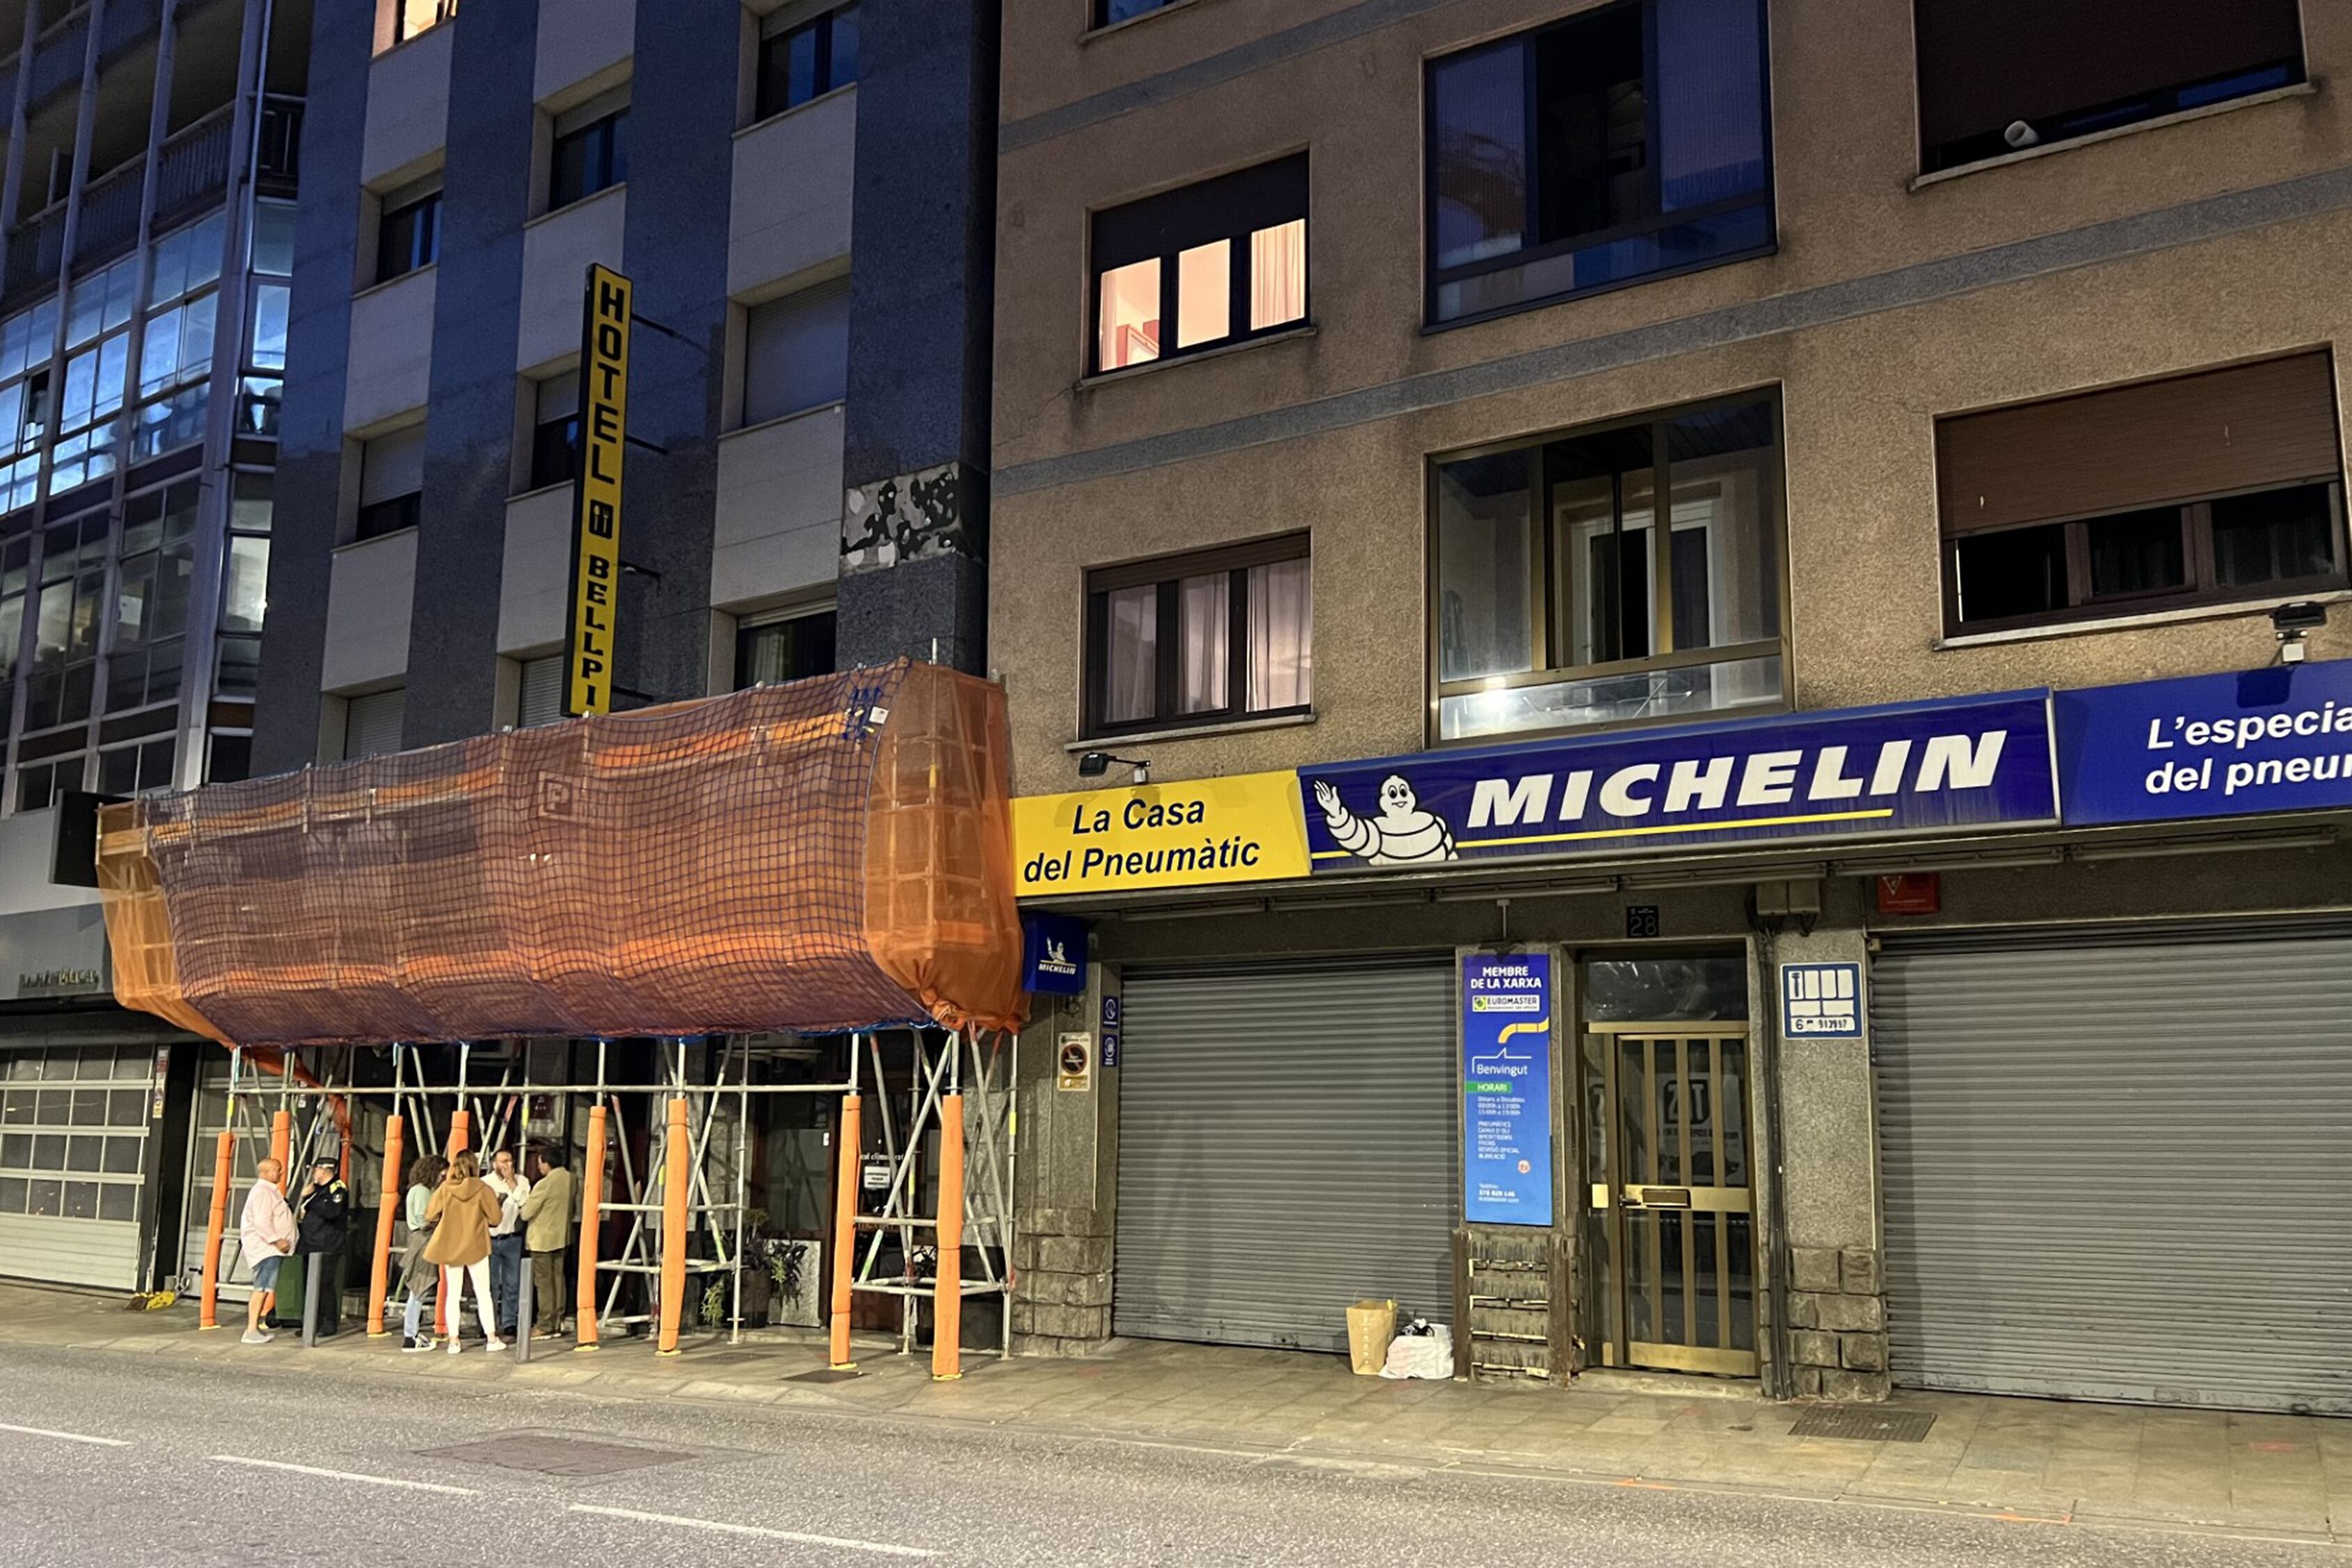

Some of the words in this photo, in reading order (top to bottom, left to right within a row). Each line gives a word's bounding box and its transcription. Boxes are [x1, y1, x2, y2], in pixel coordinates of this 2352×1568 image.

[591, 280, 625, 484] HOTEL
[582, 555, 610, 706] BELLPI
[1466, 730, 2008, 829] MICHELIN
[2145, 758, 2213, 794] del
[2224, 754, 2352, 796] pneu
[1072, 804, 1111, 835] La
[1123, 798, 1206, 829] Casa
[1024, 847, 1071, 883] del
[1081, 836, 1261, 879] Pneumàtic
[1630, 916, 1657, 937] 28
[1038, 963, 1077, 975] MICHELIN
[1482, 966, 1529, 977] MEMBRE
[1470, 978, 1484, 989] DE
[1486, 978, 1501, 989] LA
[1502, 977, 1542, 988] XARXA
[1487, 997, 1537, 1005] EUROMASTER
[1477, 1063, 1528, 1077] Benvingut
[1477, 1083, 1508, 1092] HORARI
